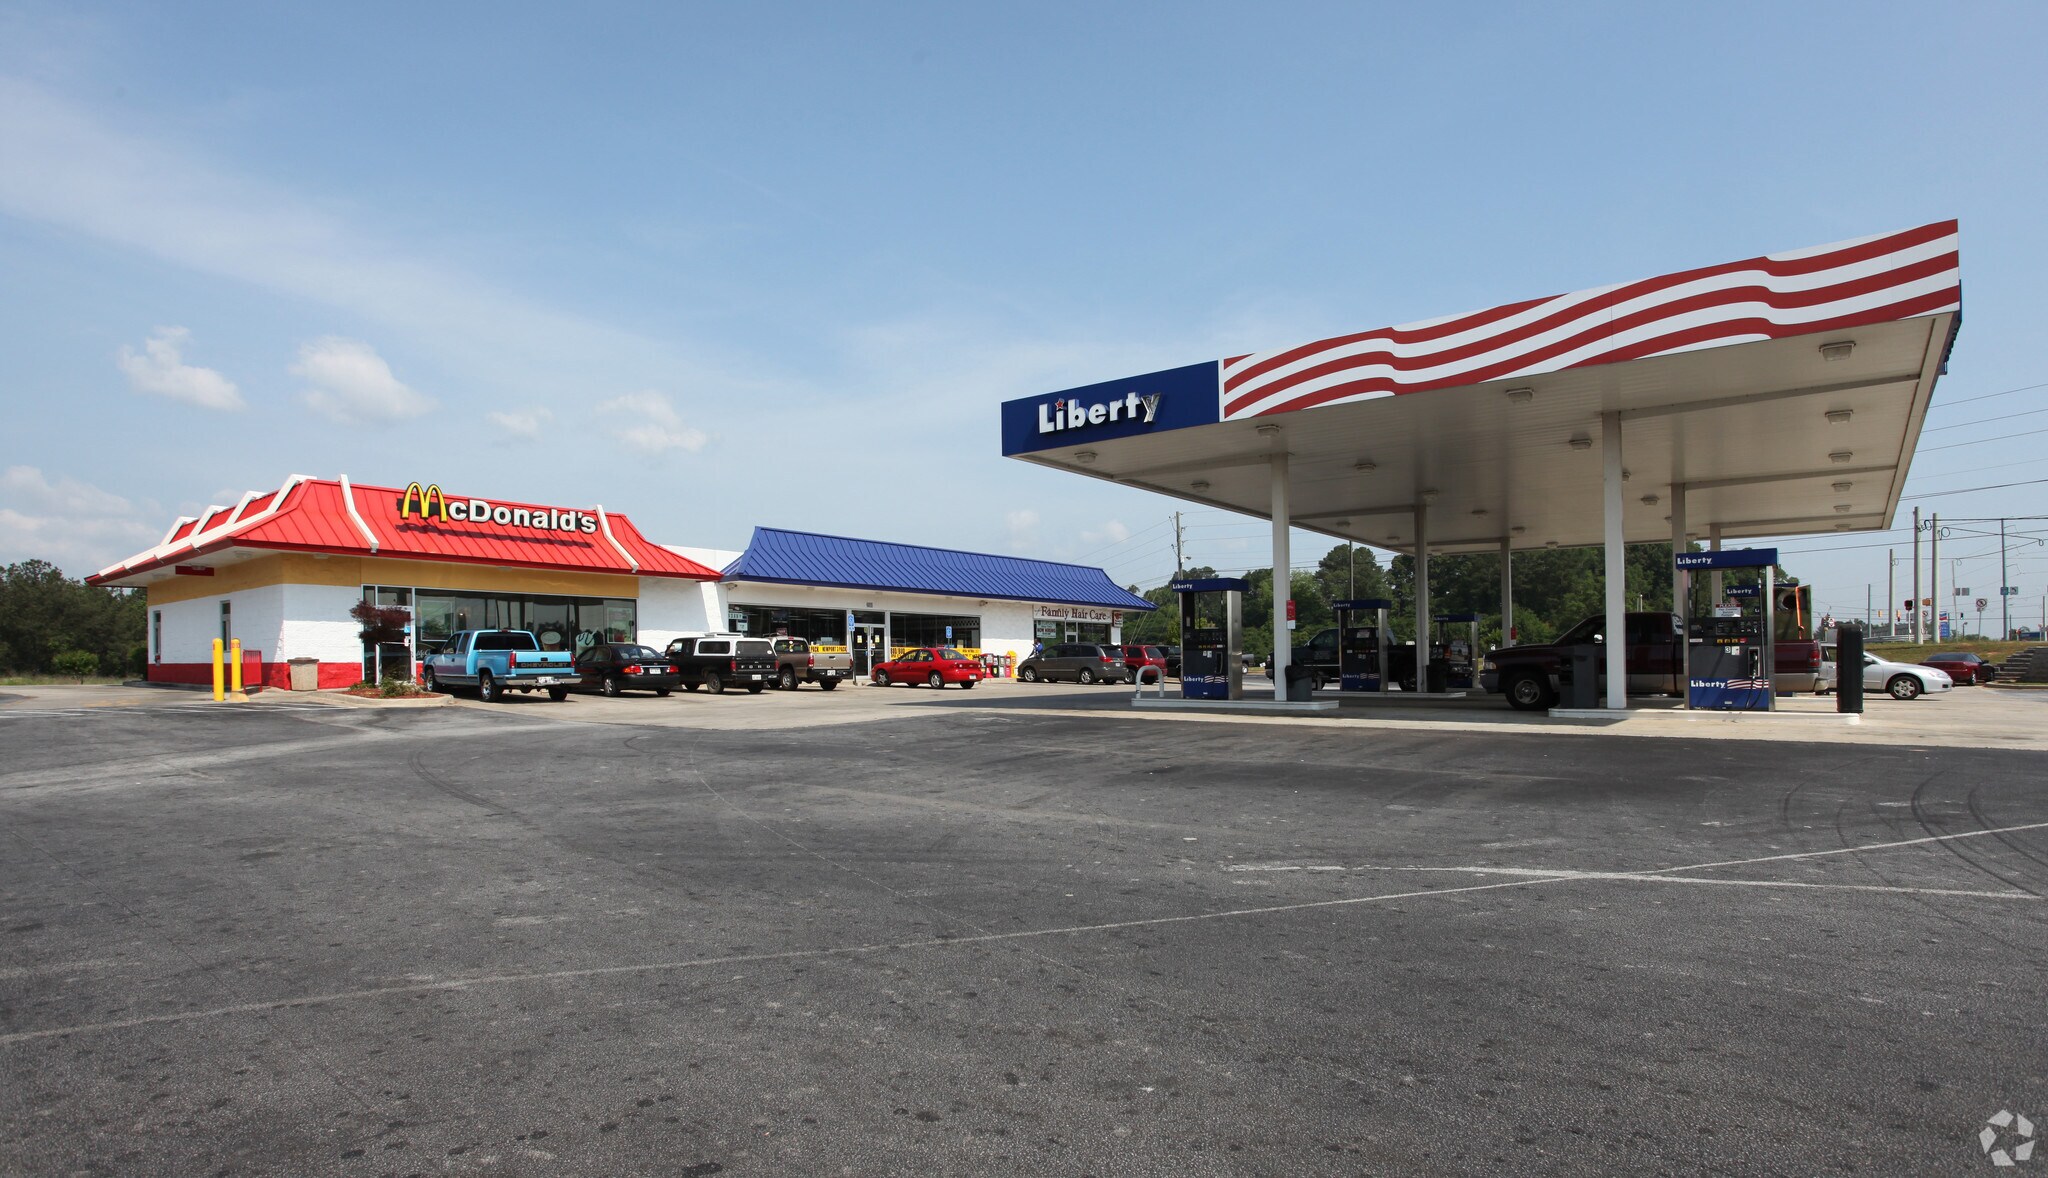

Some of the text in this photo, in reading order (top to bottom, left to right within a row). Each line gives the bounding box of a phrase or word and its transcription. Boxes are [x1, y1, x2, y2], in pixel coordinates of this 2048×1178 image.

[1038, 392, 1161, 434] Liberty
[400, 482, 597, 534] McDonald's
[1677, 557, 1712, 565] Liberty
[1041, 606, 1107, 621] Family Hair Care
[1690, 680, 1726, 689] Liberty
